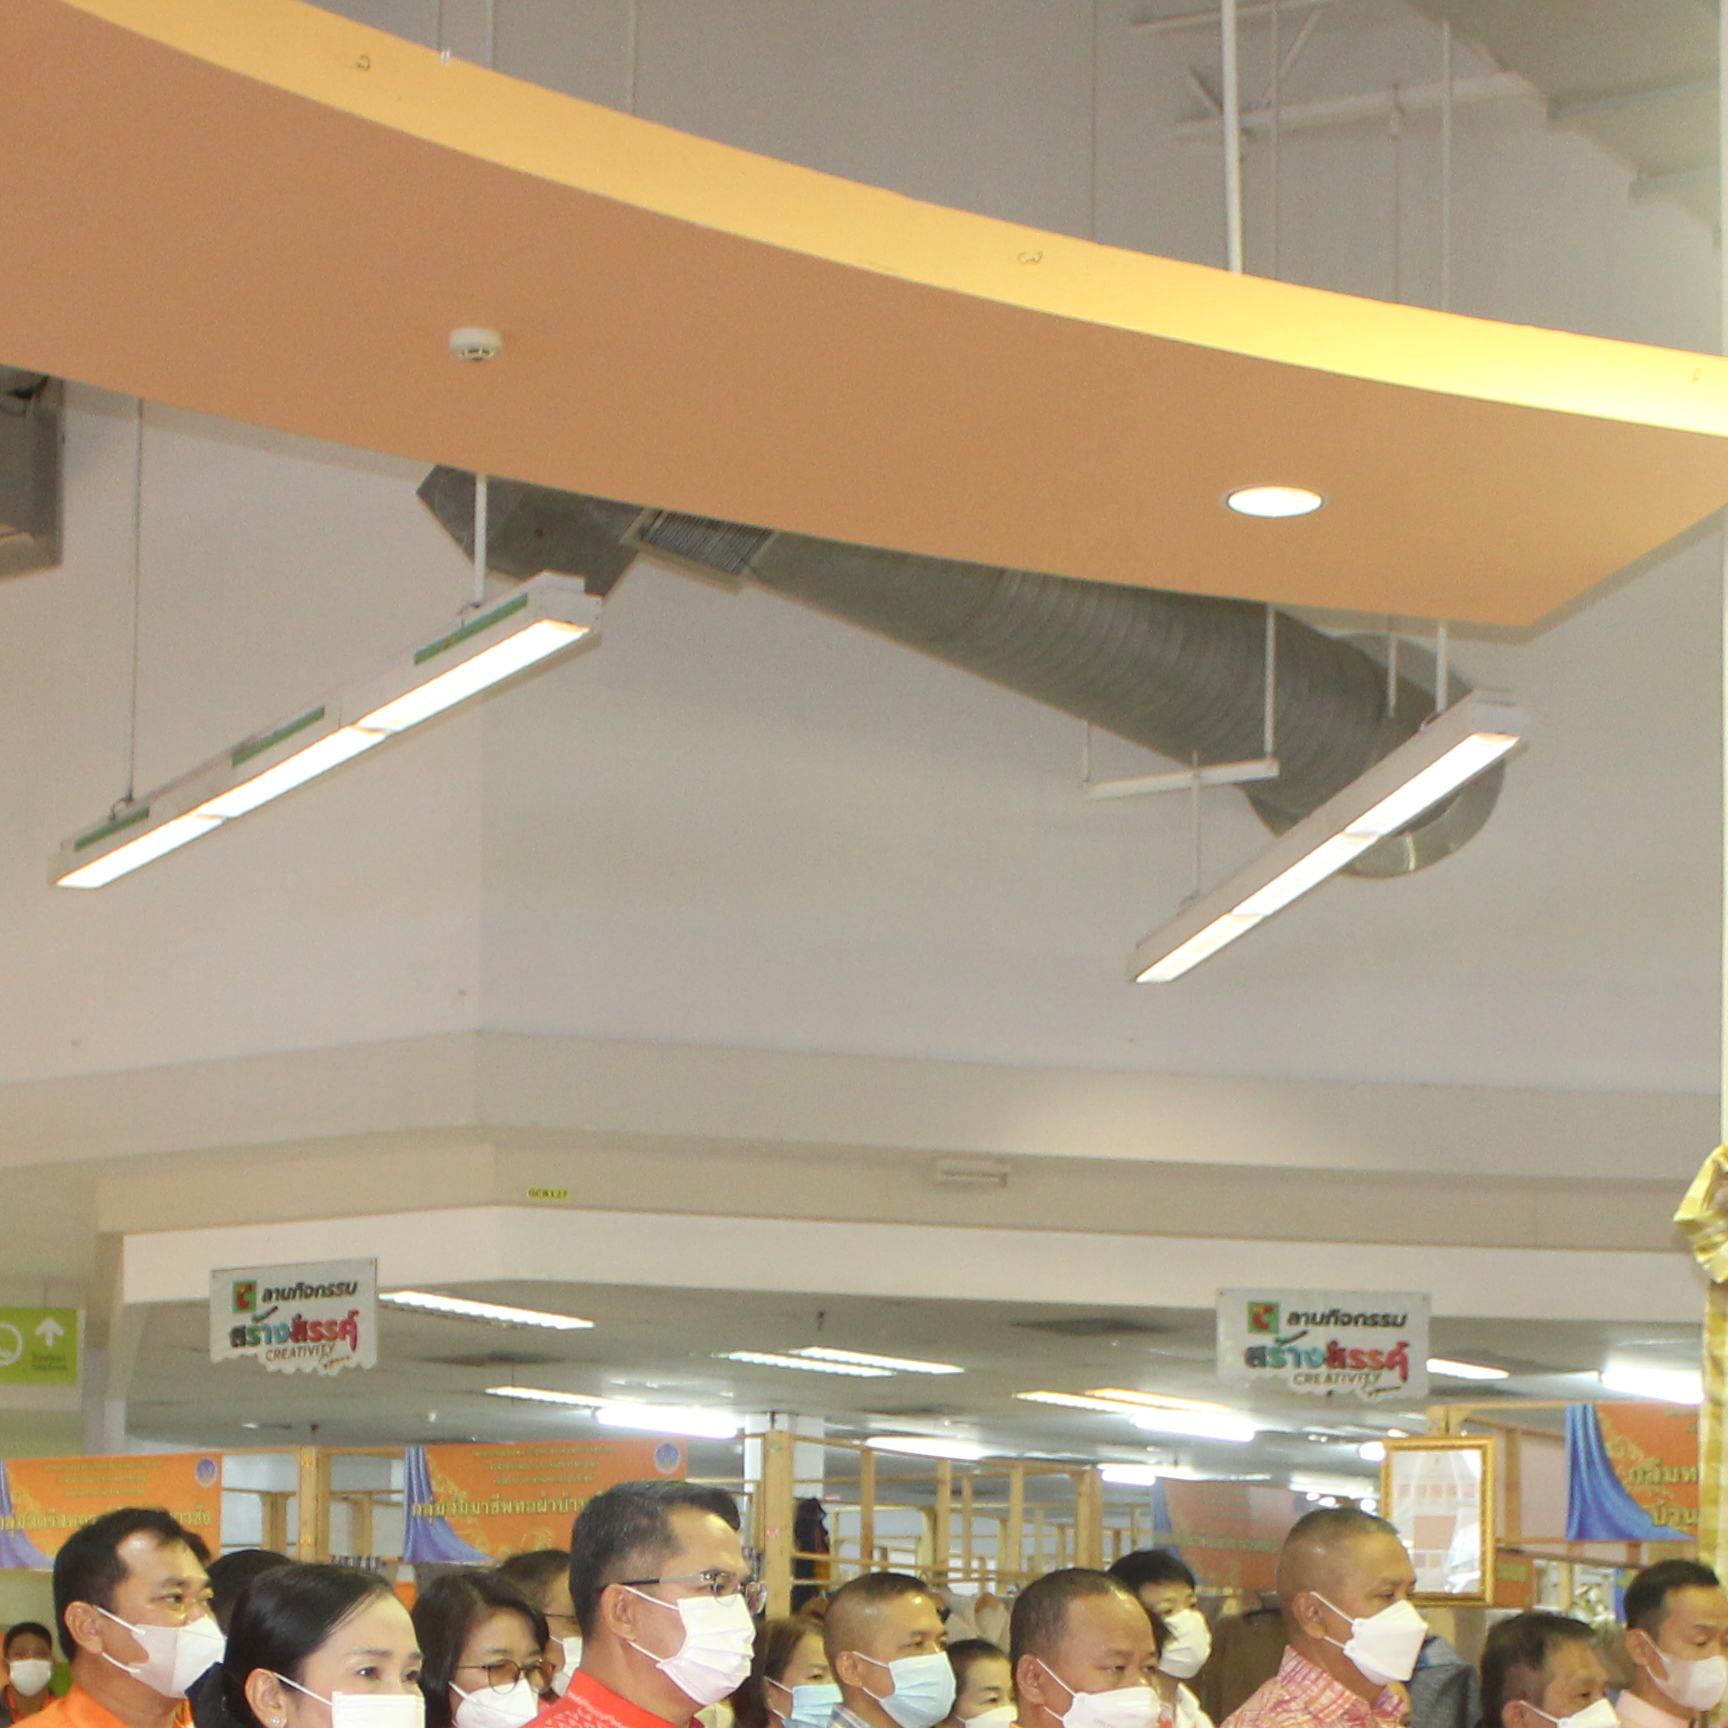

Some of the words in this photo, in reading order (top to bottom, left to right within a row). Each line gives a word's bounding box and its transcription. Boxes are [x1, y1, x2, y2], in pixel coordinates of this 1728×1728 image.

[262, 1281, 358, 1303] ลานกิจกรรม
[1287, 1308, 1408, 1328] ลานกิจกรรม
[266, 1344, 336, 1363] CREATIVITY
[1293, 1371, 1383, 1388] CREATIVITY
